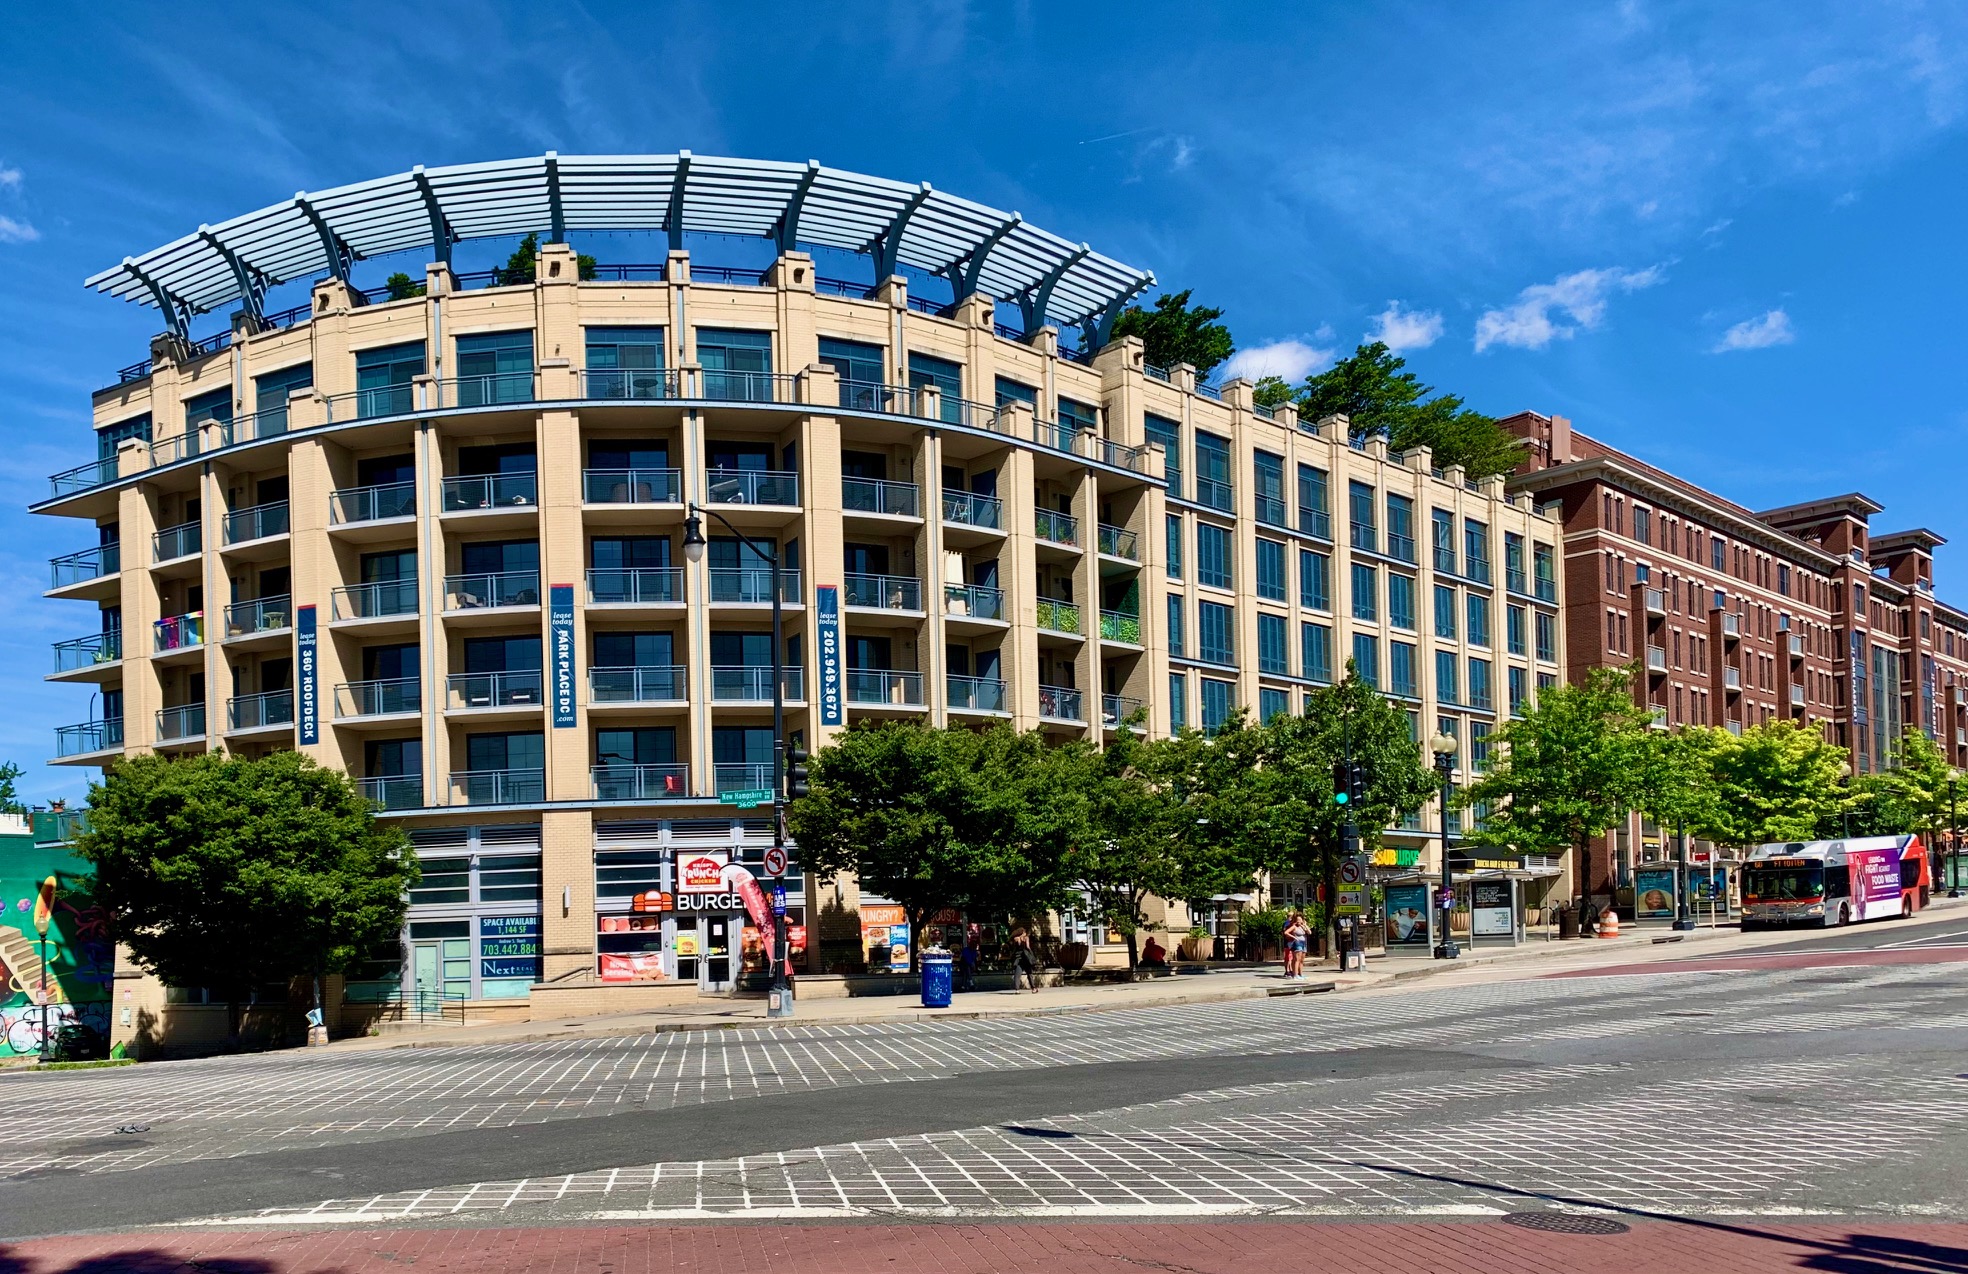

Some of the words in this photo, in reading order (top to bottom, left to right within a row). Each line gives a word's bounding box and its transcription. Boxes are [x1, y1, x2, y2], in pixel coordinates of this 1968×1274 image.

[553, 611, 572, 619] lease
[552, 618, 573, 626] today
[819, 618, 838, 627] today
[300, 632, 315, 640] lease
[299, 638, 316, 646] today
[558, 629, 569, 659] PARK
[559, 661, 570, 696] PLACE
[823, 630, 838, 719] 202.949.3670
[560, 697, 570, 714] DC
[721, 793, 733, 801] New
[734, 791, 763, 800] Hampshire
[738, 800, 757, 808] 3600
[1373, 848, 1421, 867] SUBWAY
[677, 893, 747, 911] BURGE
[860, 910, 899, 923] HUNGRY?
[483, 918, 504, 927] SPACE
[498, 926, 517, 936] 1,144
[519, 925, 527, 934] SF
[483, 961, 515, 975] Next
